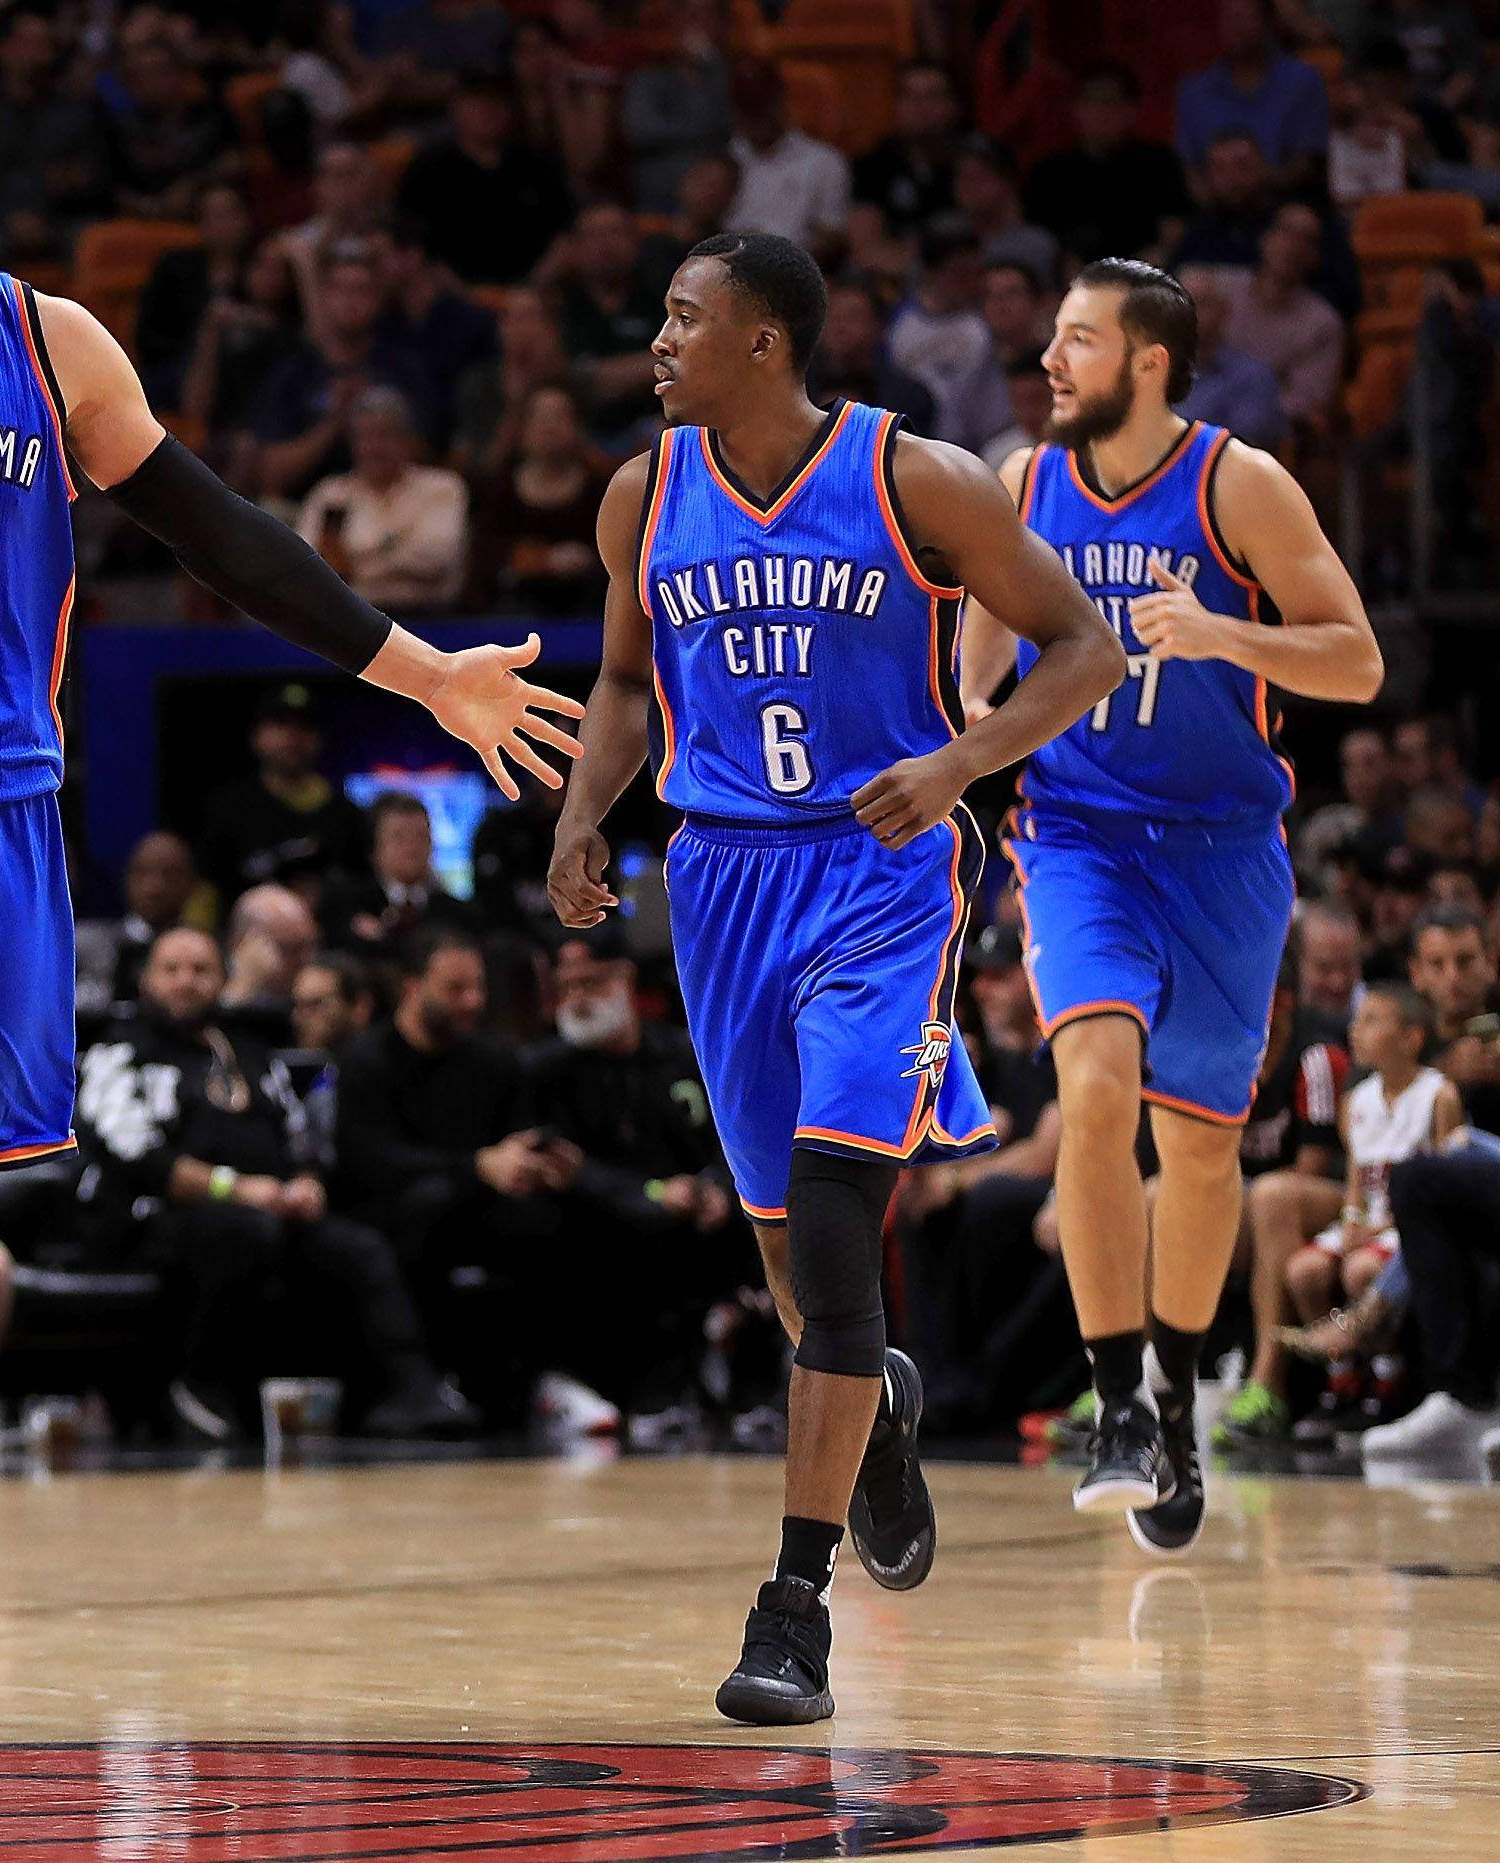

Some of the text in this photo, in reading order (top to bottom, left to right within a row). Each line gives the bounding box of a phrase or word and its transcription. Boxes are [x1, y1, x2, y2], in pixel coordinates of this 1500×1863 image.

[657, 555, 888, 628] OKLAHOMA
[721, 624, 814, 676] CITY
[760, 702, 815, 795] 6
